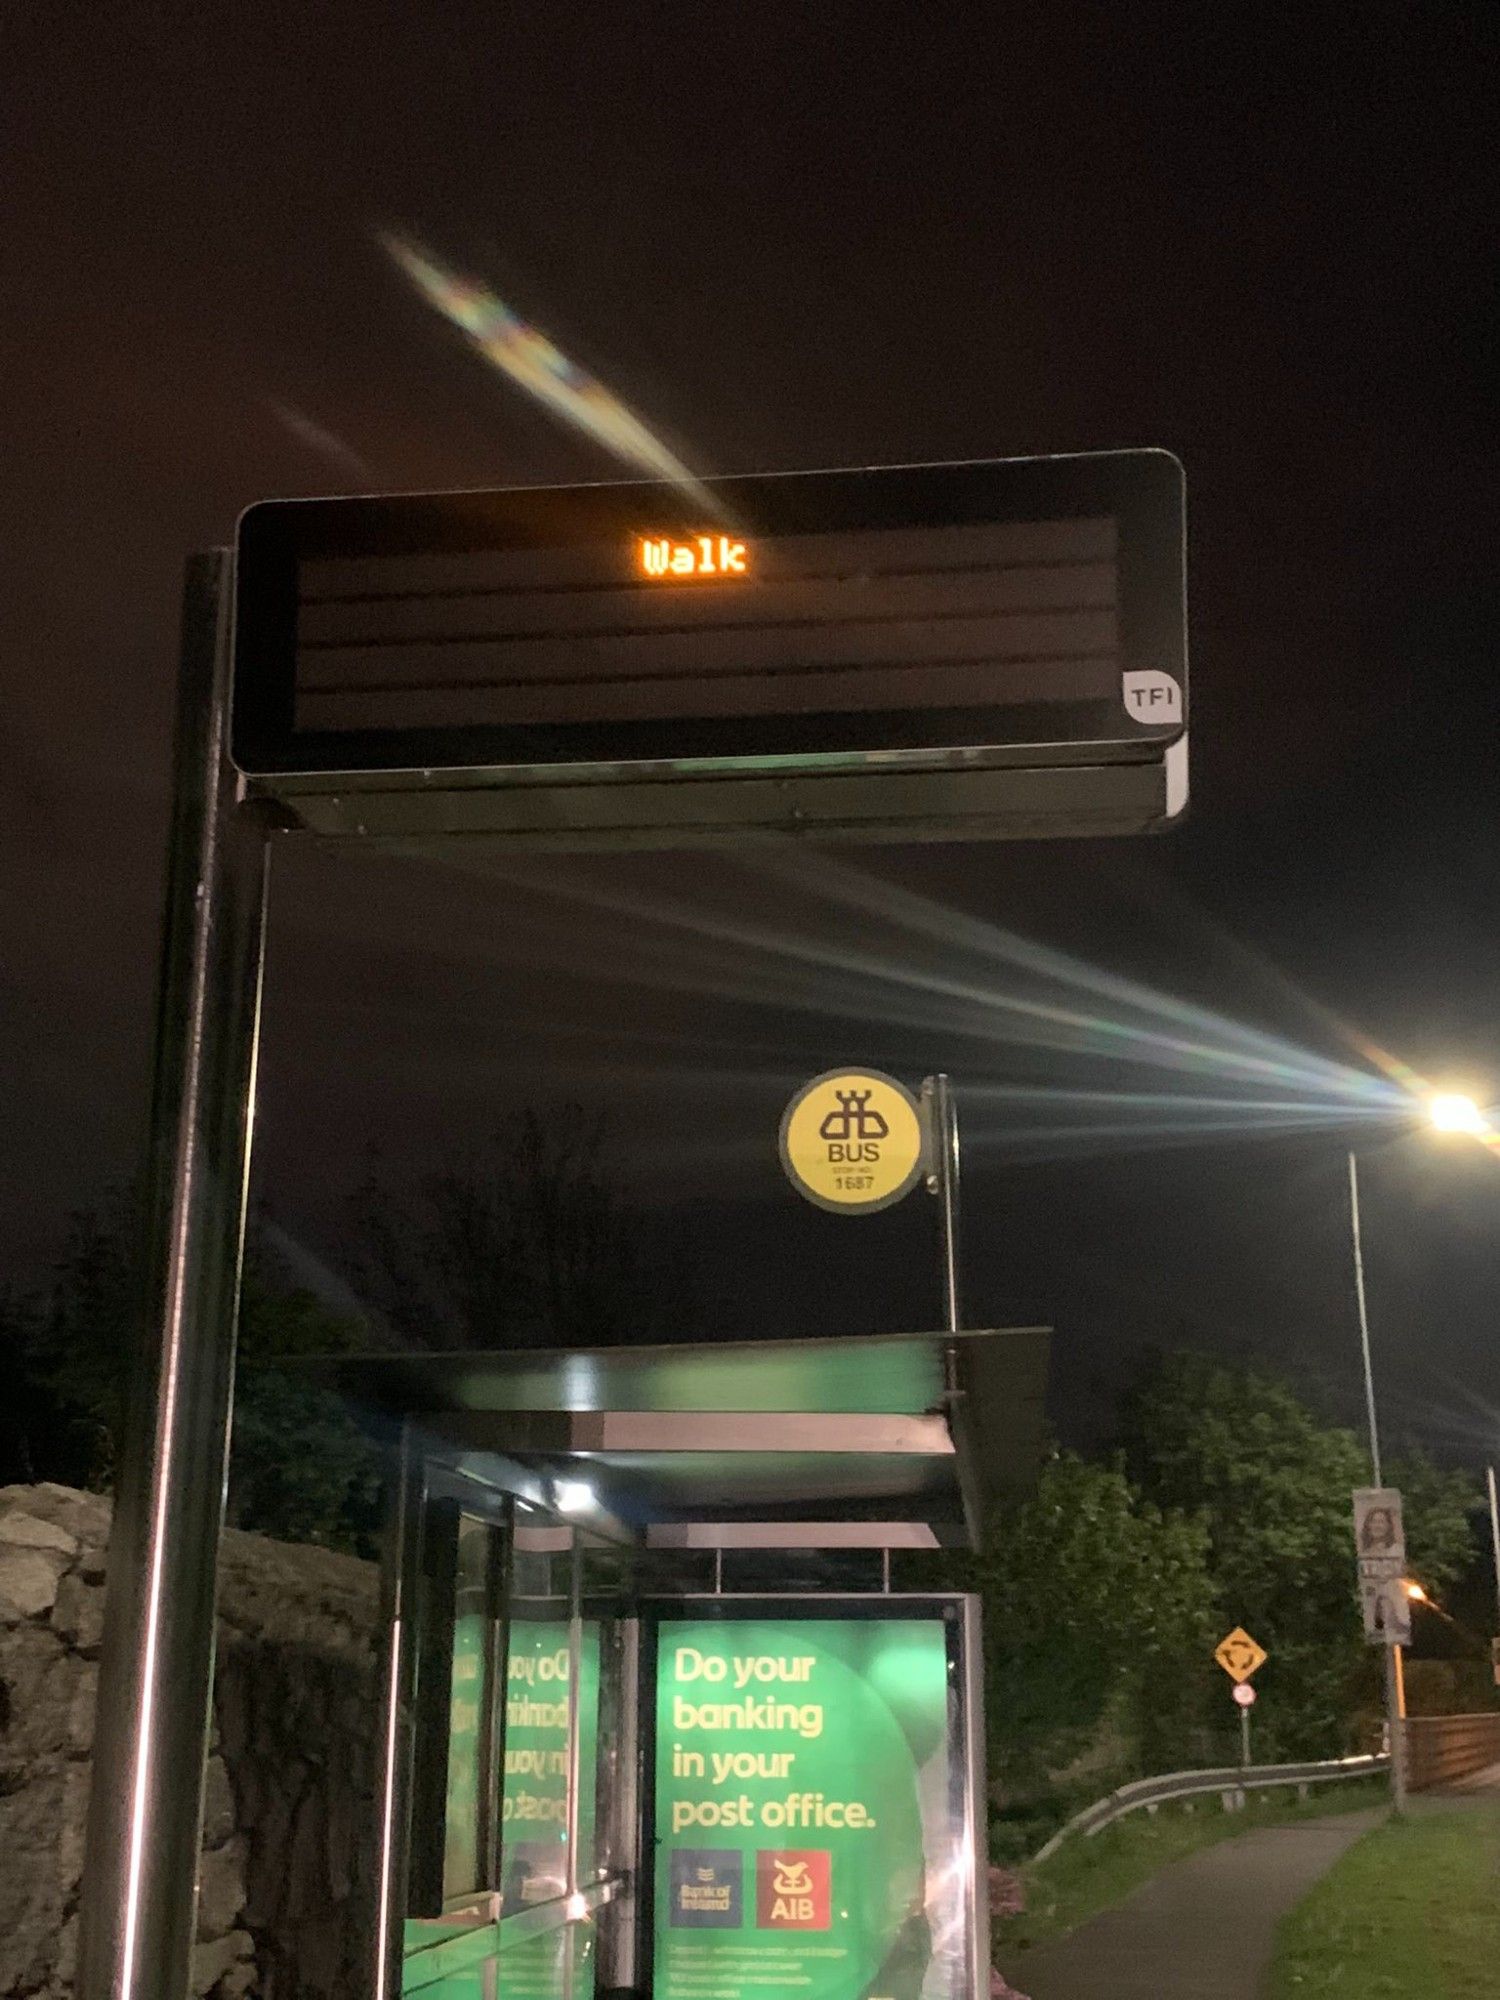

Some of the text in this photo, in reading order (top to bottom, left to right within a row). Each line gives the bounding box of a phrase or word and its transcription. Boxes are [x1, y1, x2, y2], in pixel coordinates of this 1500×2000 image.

[642, 536, 746, 576] Walk
[1131, 686, 1173, 707] TFI
[828, 1143, 880, 1163] BUS
[674, 1648, 817, 1689] Do your
[673, 1695, 823, 1738] banking
[673, 1743, 795, 1785] in your
[672, 1792, 876, 1835] post office.
[770, 1898, 815, 1921] AIB
